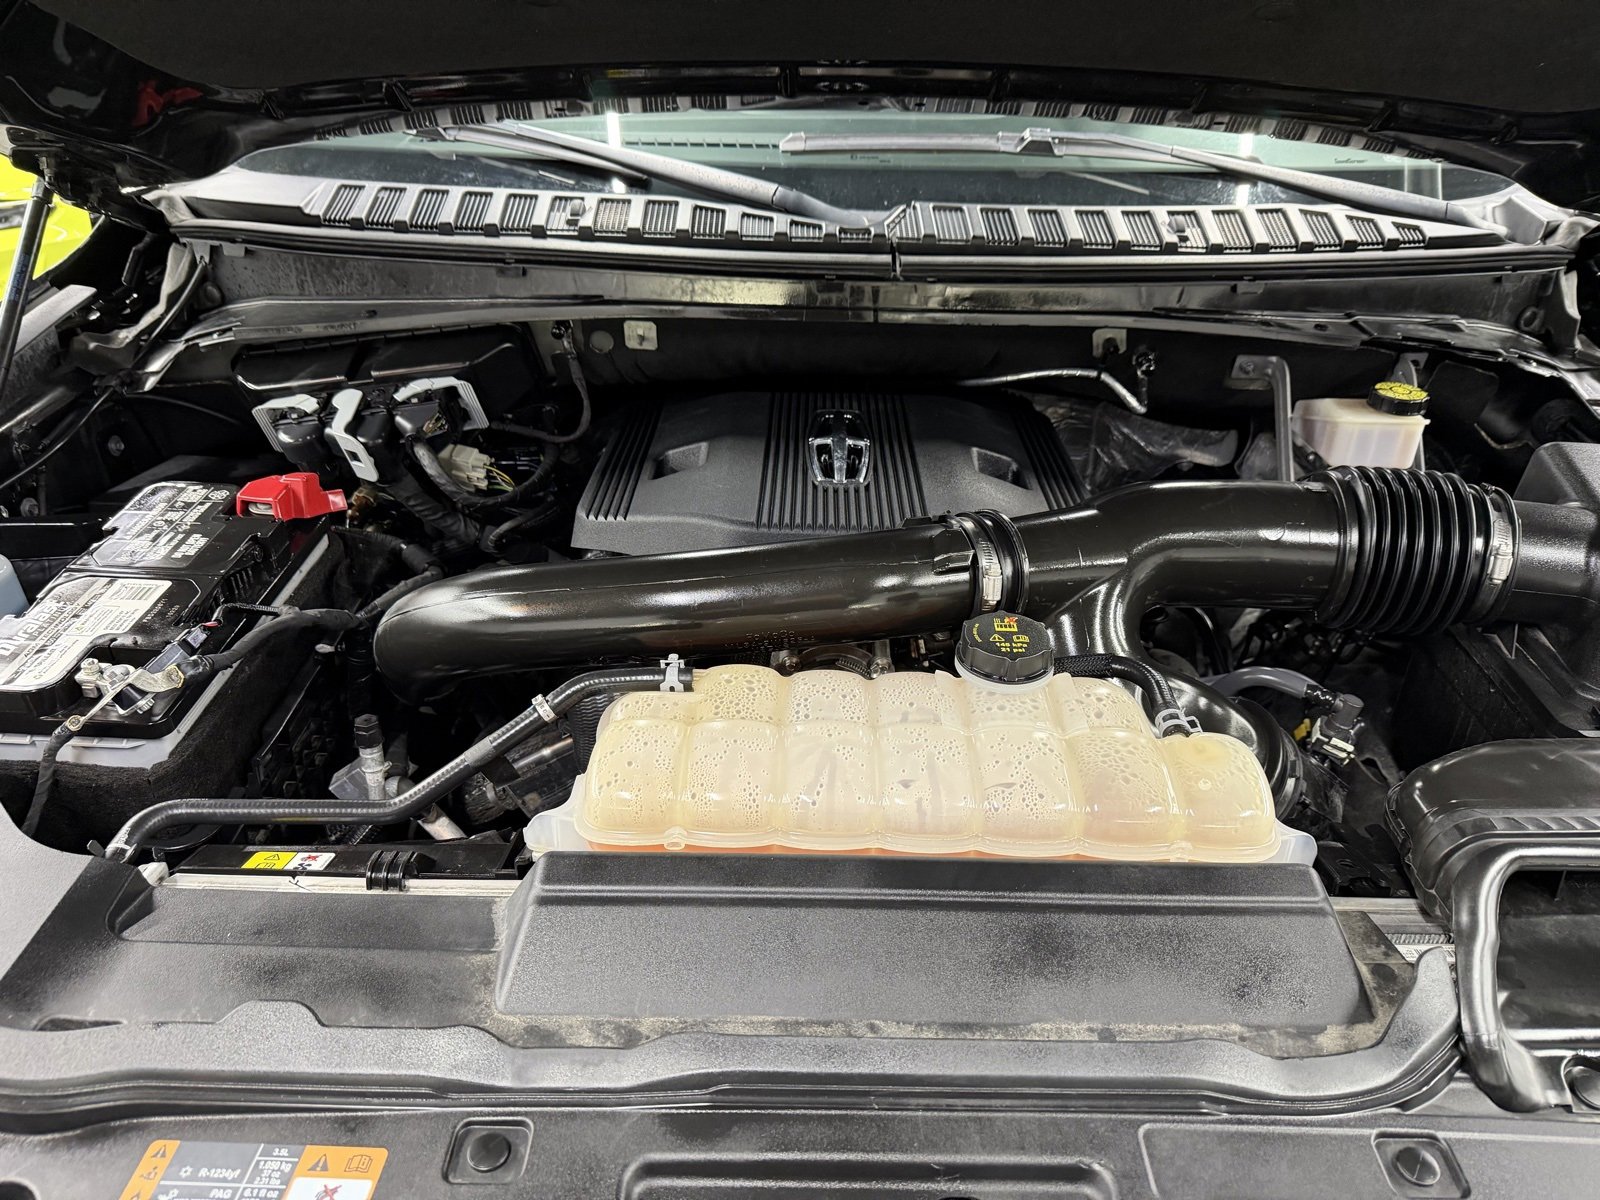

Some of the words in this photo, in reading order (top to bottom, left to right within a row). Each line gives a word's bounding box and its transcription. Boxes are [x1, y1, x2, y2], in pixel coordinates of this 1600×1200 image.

[280, 1162, 292, 1173] kg
[198, 1167, 242, 1180] R-1234yf
[209, 1189, 233, 1199] PAG
